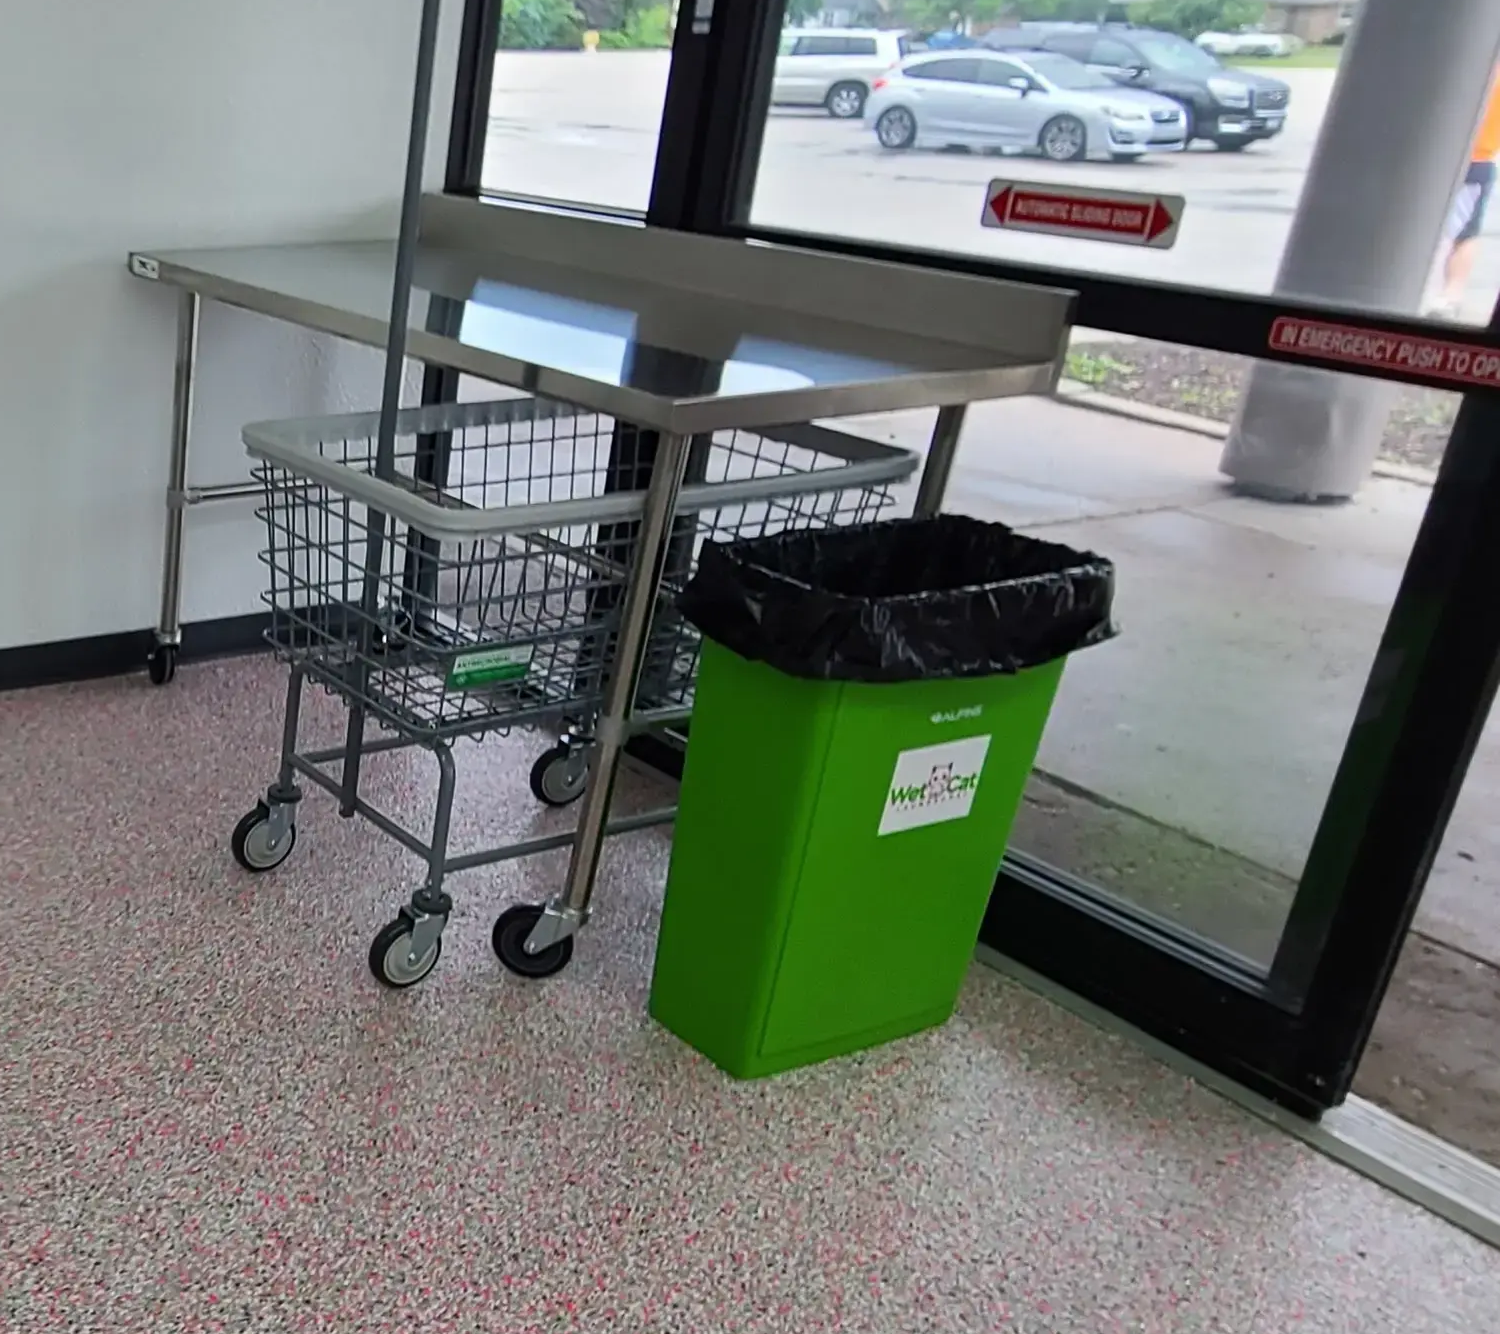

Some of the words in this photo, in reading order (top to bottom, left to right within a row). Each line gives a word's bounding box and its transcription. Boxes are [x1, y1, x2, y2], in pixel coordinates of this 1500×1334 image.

[1014, 198, 1070, 221] AUTOMATIC
[1070, 204, 1112, 225] SLIDING
[1111, 209, 1145, 228] DOOR
[1280, 323, 1298, 344] IN
[1298, 327, 1398, 361] EMERGENCY
[1396, 342, 1444, 368] PUSH
[1445, 350, 1470, 374] TO
[891, 783, 928, 805] Wet
[947, 772, 977, 793] Cat
